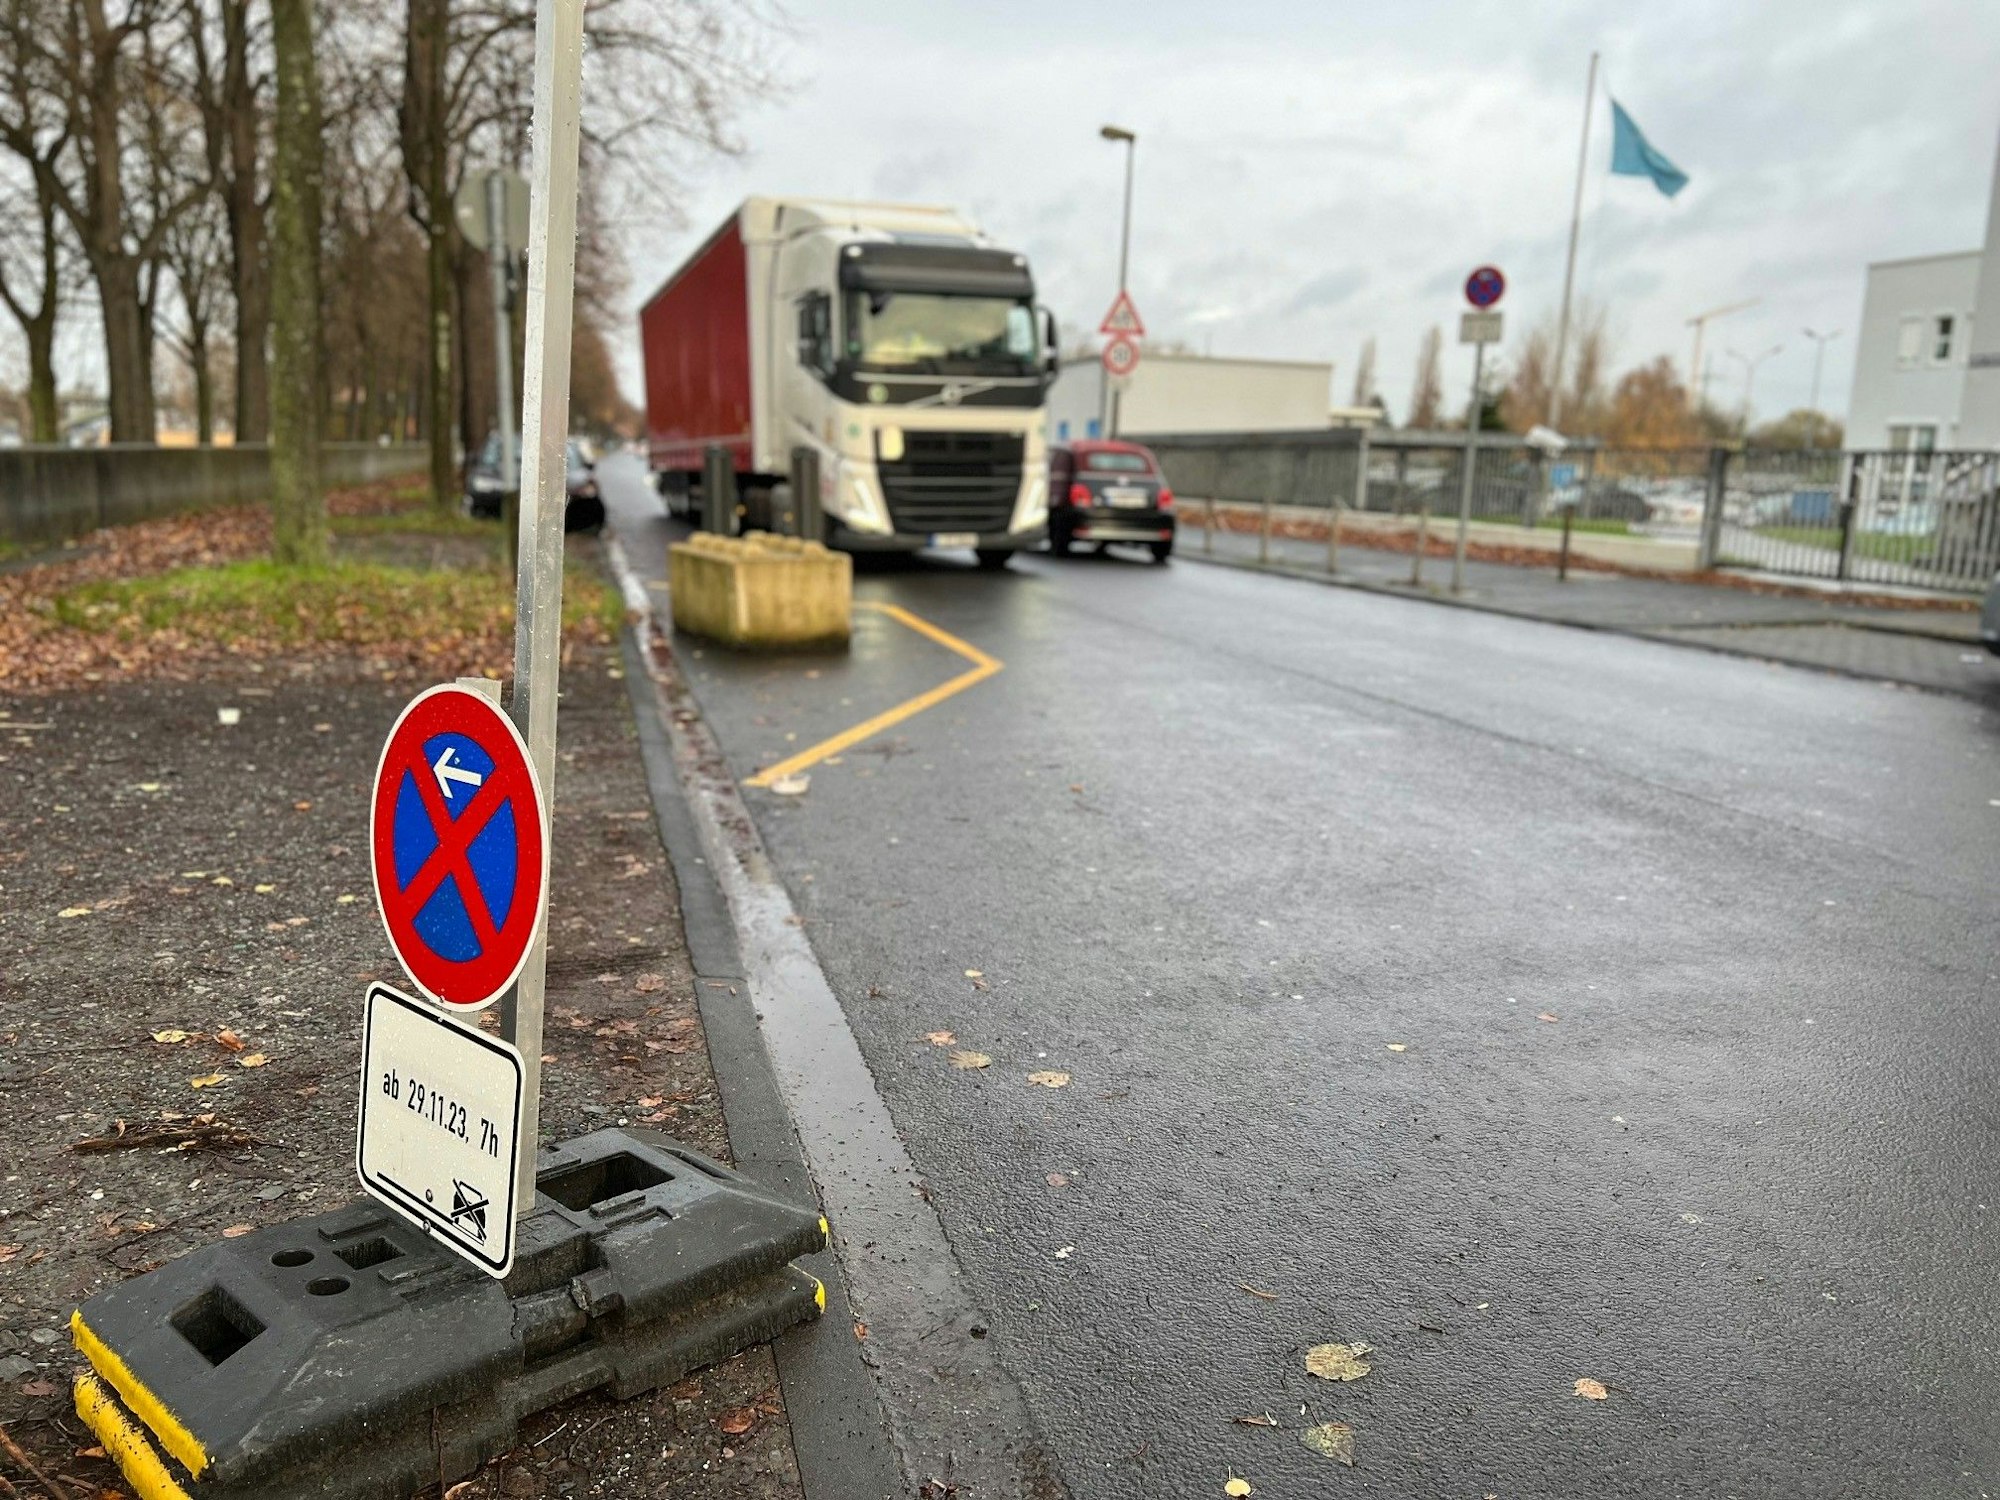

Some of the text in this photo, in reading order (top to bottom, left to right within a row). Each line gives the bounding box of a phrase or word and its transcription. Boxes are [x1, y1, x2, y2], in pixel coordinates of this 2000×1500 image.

[383, 1068, 499, 1158] ab 29.11.23, 7h
